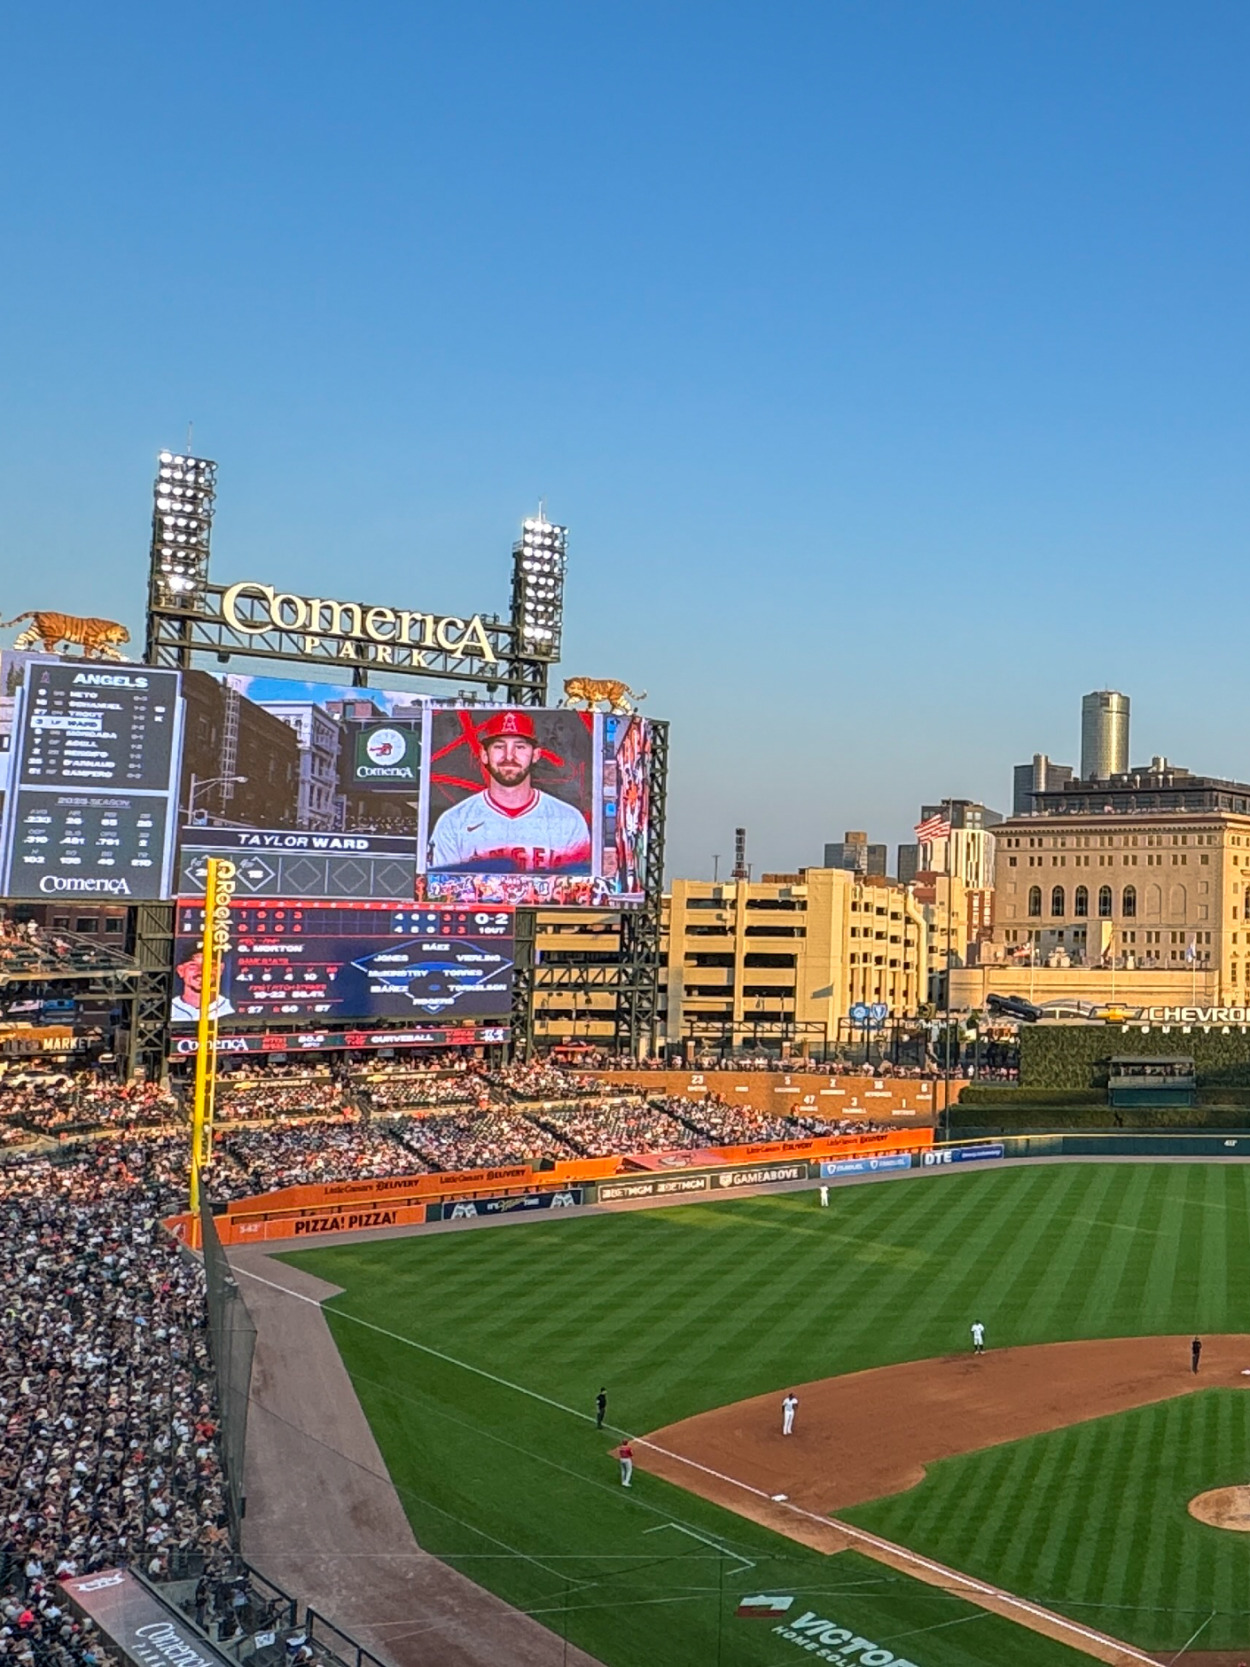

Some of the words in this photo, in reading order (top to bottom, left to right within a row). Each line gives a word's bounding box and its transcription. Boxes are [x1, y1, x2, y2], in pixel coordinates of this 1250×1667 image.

[304, 635, 427, 668] PARK
[72, 673, 149, 688] ANGELS
[89, 798, 131, 806] SEASON
[238, 833, 309, 847] TAYLOR
[312, 836, 369, 850] WARD
[241, 911, 248, 919] 1
[394, 913, 404, 921] 4
[474, 913, 508, 925] 0-2
[253, 944, 304, 953] MORTON
[374, 954, 409, 962] JONES
[329, 973, 336, 981] 1
[43, 1037, 93, 1050] MARKET
[692, 1075, 704, 1084] 23
[804, 1095, 815, 1104] 47
[852, 1097, 858, 1106] 3
[924, 1151, 953, 1165] DTE
[733, 1168, 799, 1185] GAMEABOVE
[295, 1214, 345, 1235] PIZZA!
[348, 1211, 397, 1229] PIZZA!
[771, 1625, 820, 1651] HOME
